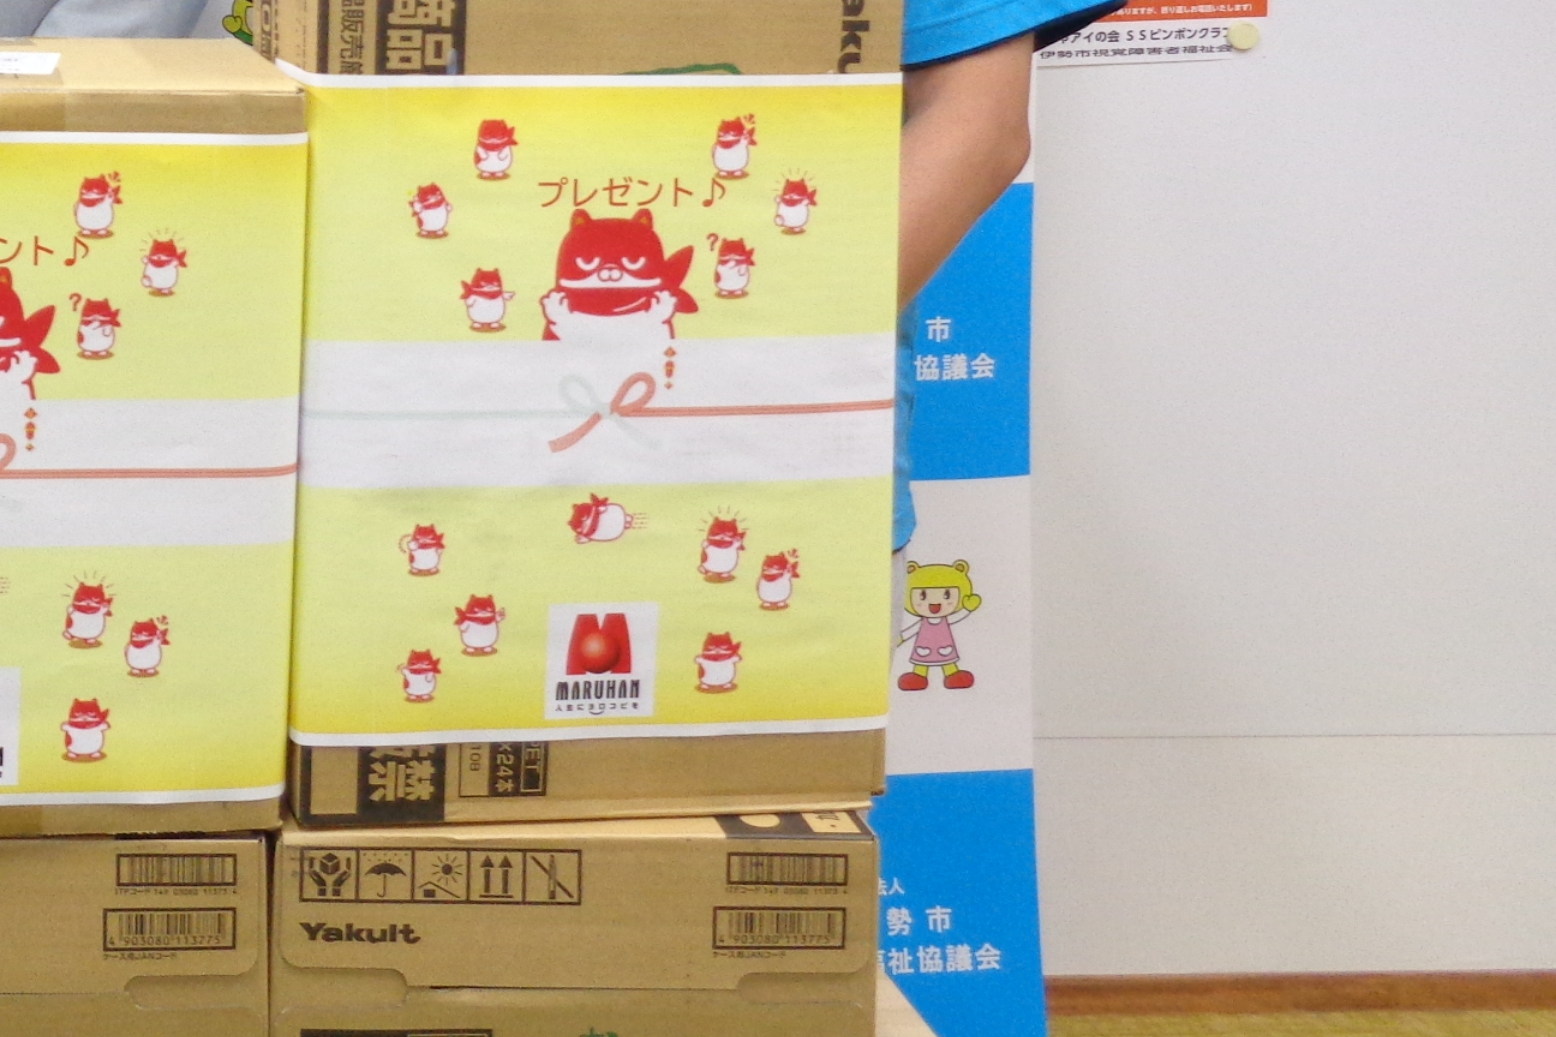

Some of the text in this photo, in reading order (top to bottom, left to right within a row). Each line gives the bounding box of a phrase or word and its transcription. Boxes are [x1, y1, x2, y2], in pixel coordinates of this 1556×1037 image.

[926, 316, 951, 342] 市
[914, 352, 995, 381] 協議会
[555, 679, 640, 700] MARUHAN
[124, 935, 170, 946] 903080
[176, 934, 221, 945] 113775
[299, 922, 421, 945] Yakult
